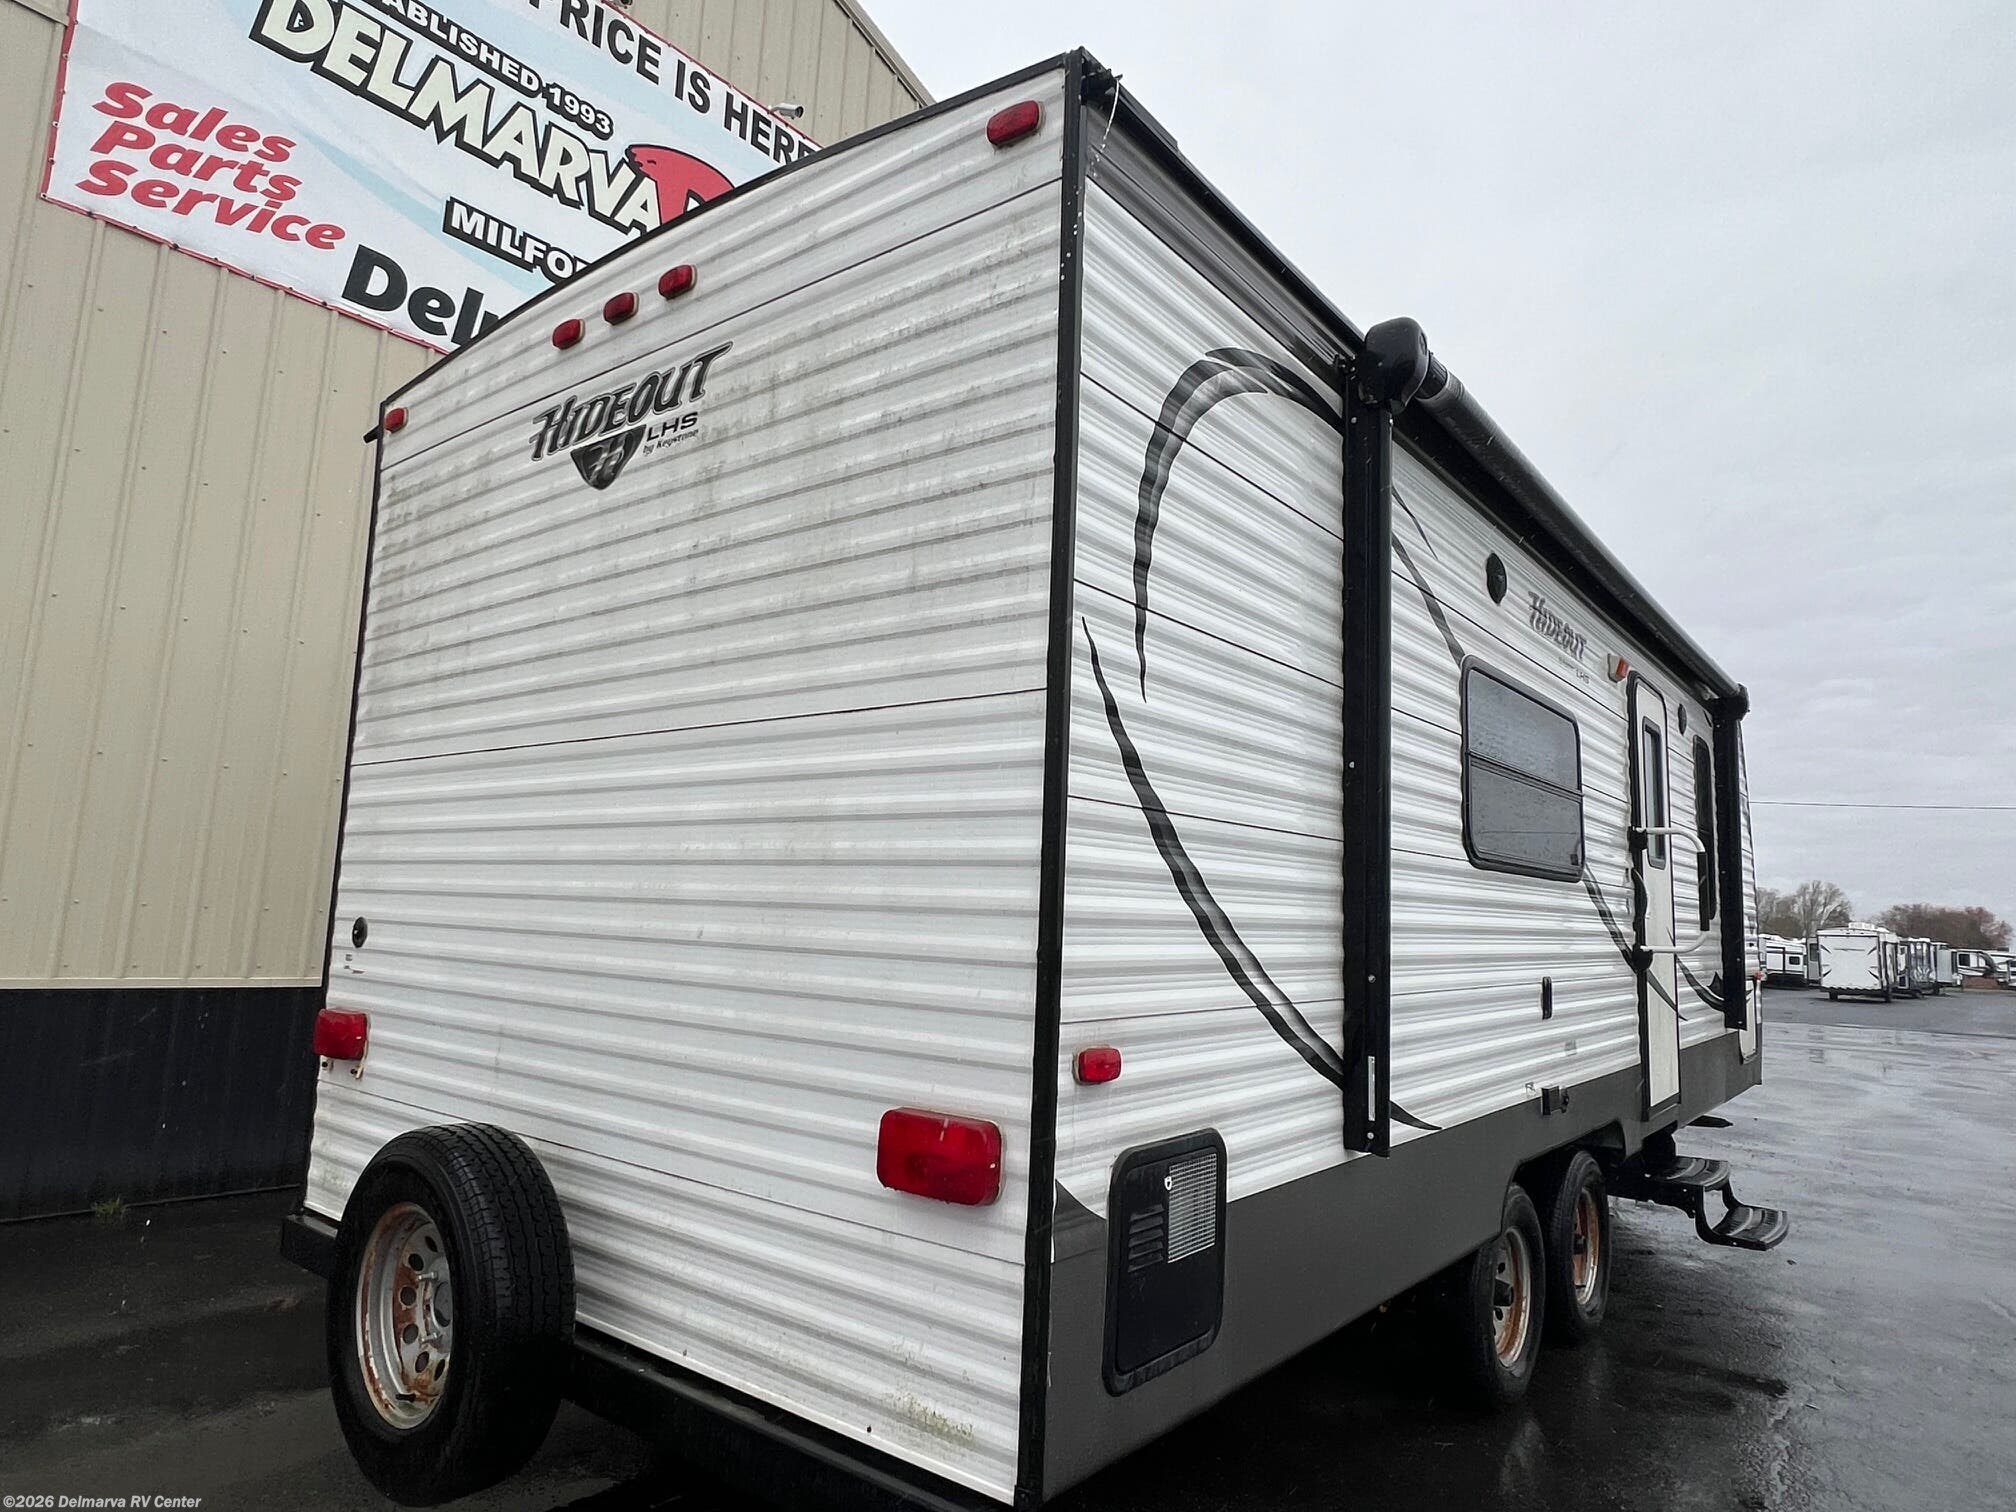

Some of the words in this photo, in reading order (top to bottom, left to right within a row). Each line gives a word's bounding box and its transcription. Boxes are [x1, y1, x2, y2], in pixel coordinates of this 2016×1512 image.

[530, 0, 661, 85] RICE
[675, 59, 711, 114] IS
[92, 81, 296, 162] Sales
[250, 0, 662, 232] DELMARVA
[549, 87, 610, 134] 1993
[90, 121, 302, 201] Parts
[75, 160, 345, 250] Service
[342, 244, 499, 346] Del
[647, 412, 698, 442] LHS
